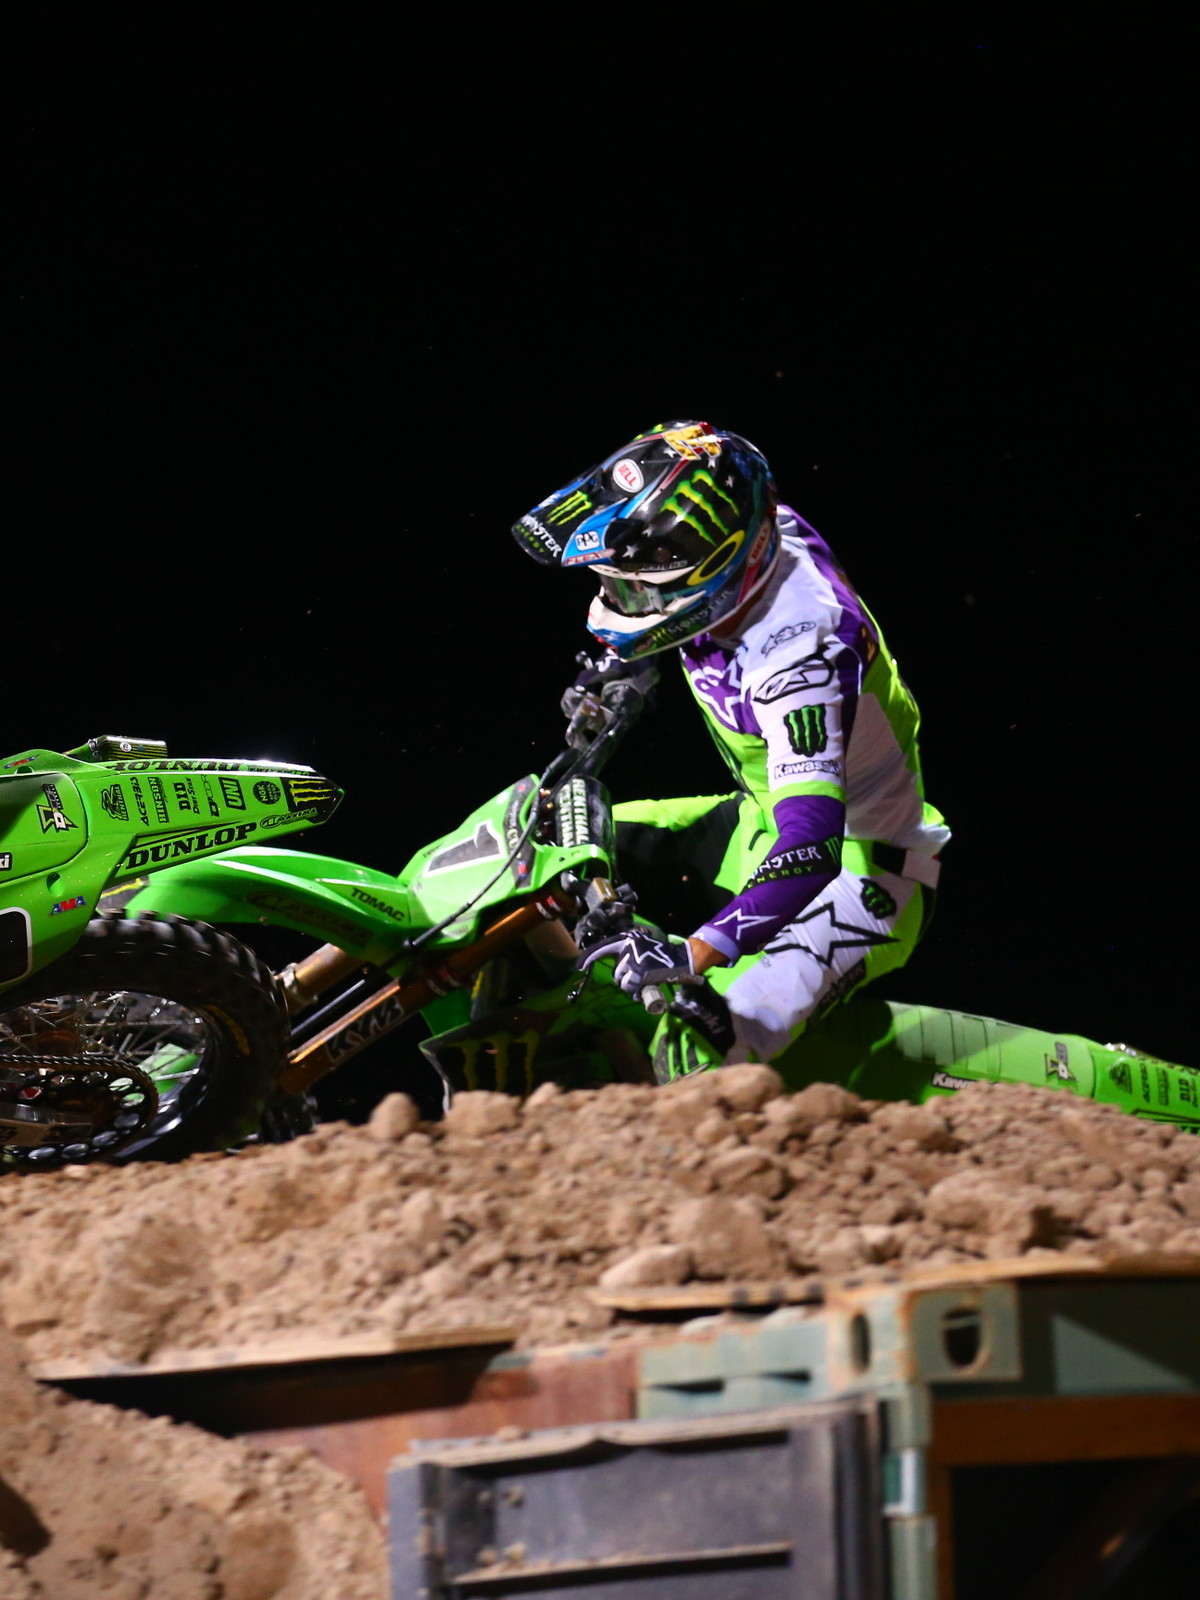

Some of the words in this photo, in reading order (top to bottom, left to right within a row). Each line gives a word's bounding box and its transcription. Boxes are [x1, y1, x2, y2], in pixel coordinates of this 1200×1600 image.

[617, 463, 638, 487] BELL
[148, 777, 170, 823] HINSON
[222, 778, 244, 809] UNI
[257, 784, 269, 801] NGK
[571, 778, 590, 845] RENTHAL
[126, 821, 257, 870] DUNLOP
[424, 820, 505, 877] 1
[750, 846, 822, 880] NSTER
[48, 895, 88, 917] AMA
[351, 887, 405, 922] TOMAC
